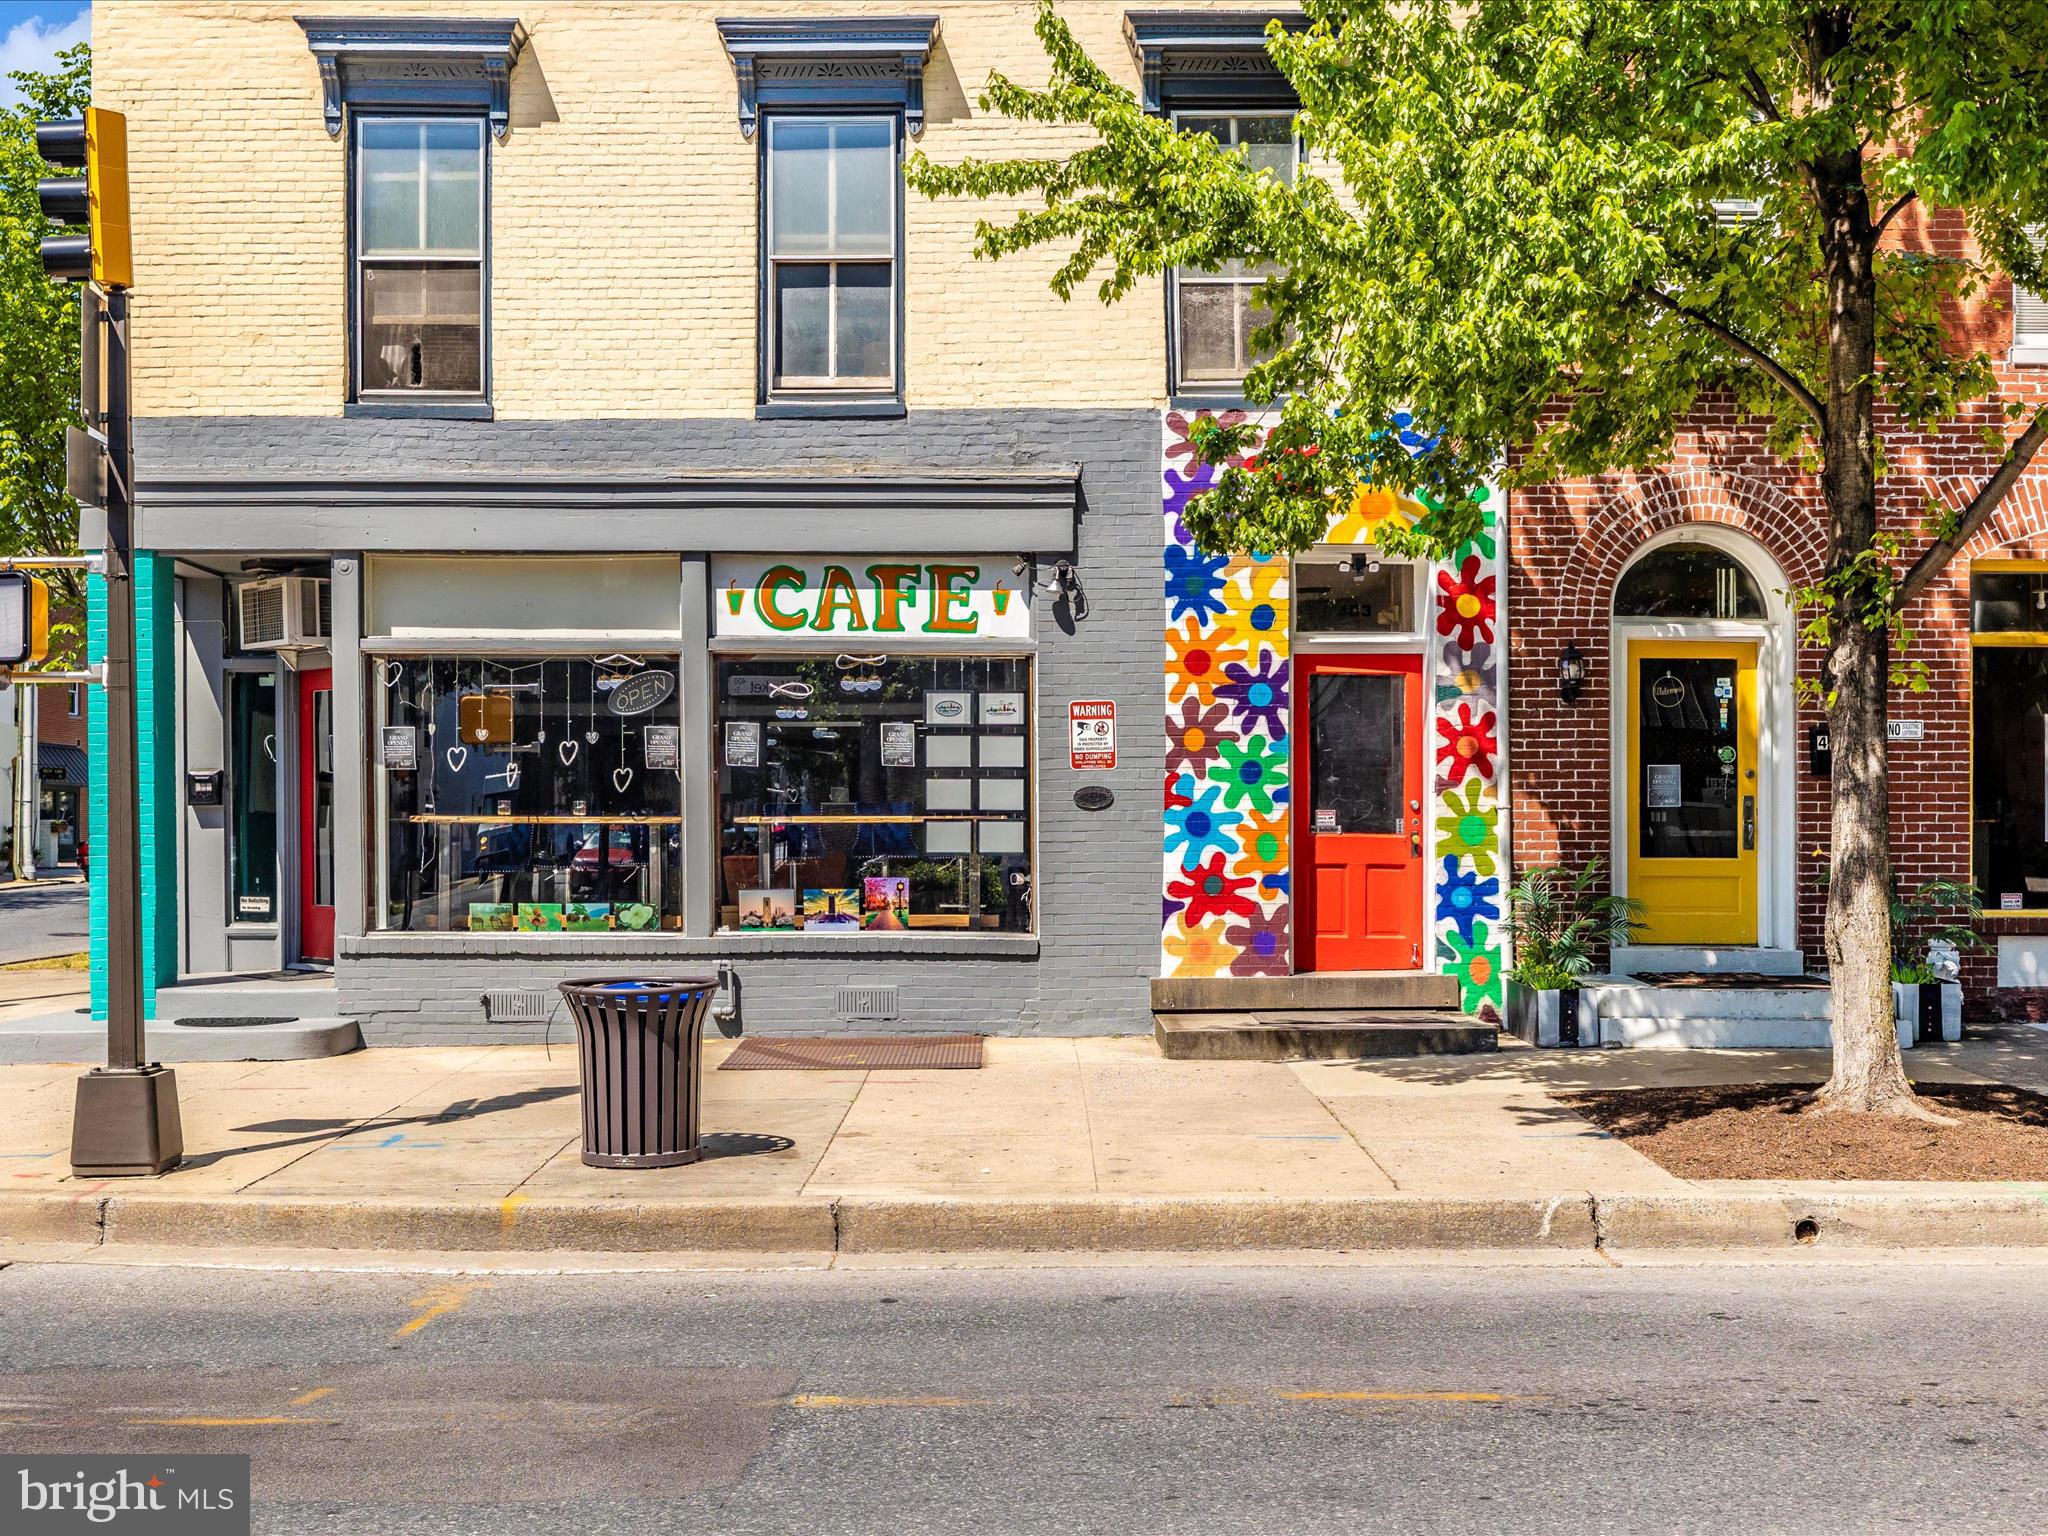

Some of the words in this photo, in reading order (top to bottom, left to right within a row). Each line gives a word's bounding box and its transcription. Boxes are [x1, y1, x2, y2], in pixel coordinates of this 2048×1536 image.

[754, 564, 980, 634] CAFE
[616, 676, 666, 709] OPEN
[1072, 704, 1112, 717] WARNING
[1888, 723, 1900, 736] NO
